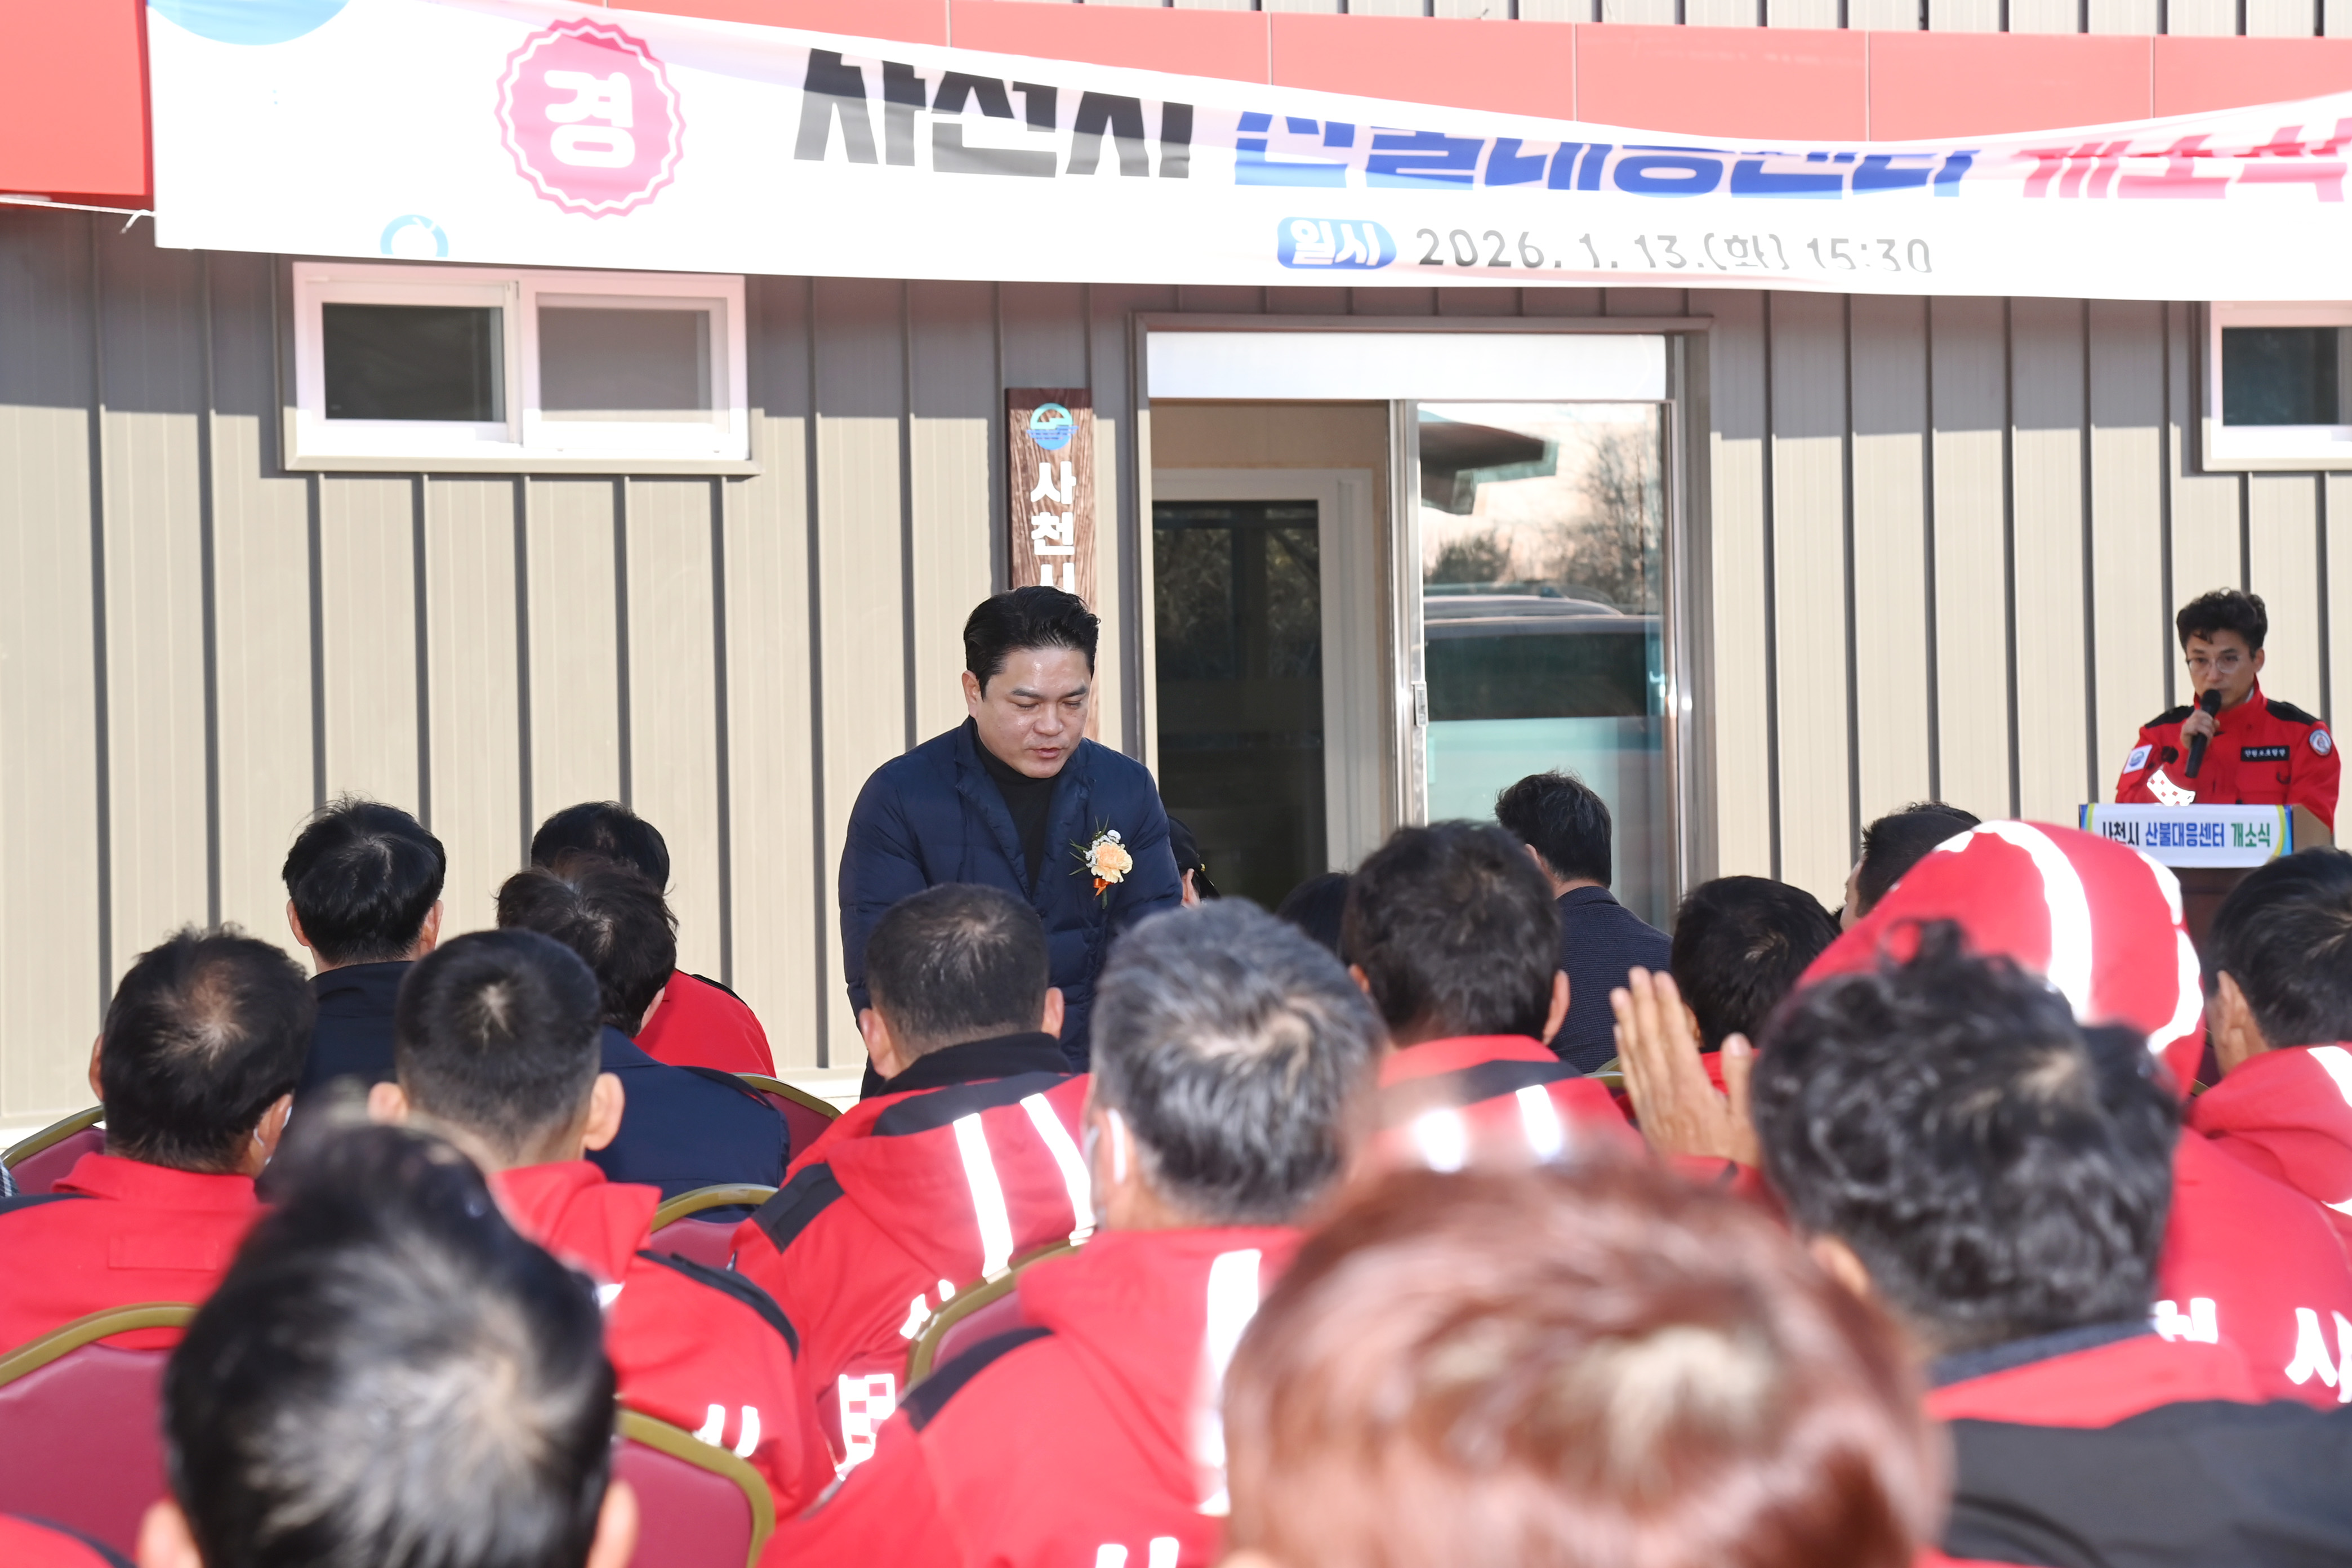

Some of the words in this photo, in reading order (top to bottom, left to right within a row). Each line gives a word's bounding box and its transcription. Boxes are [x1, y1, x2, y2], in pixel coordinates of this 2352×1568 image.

[545, 69, 636, 169] 경
[1289, 219, 1382, 266] 일시
[1415, 228, 1563, 269] 2026.
[1578, 232, 1619, 269] 1.
[1806, 236, 1934, 274] 15:30
[2145, 821, 2225, 848] 산불대응센터
[2230, 821, 2271, 848] 개소식
